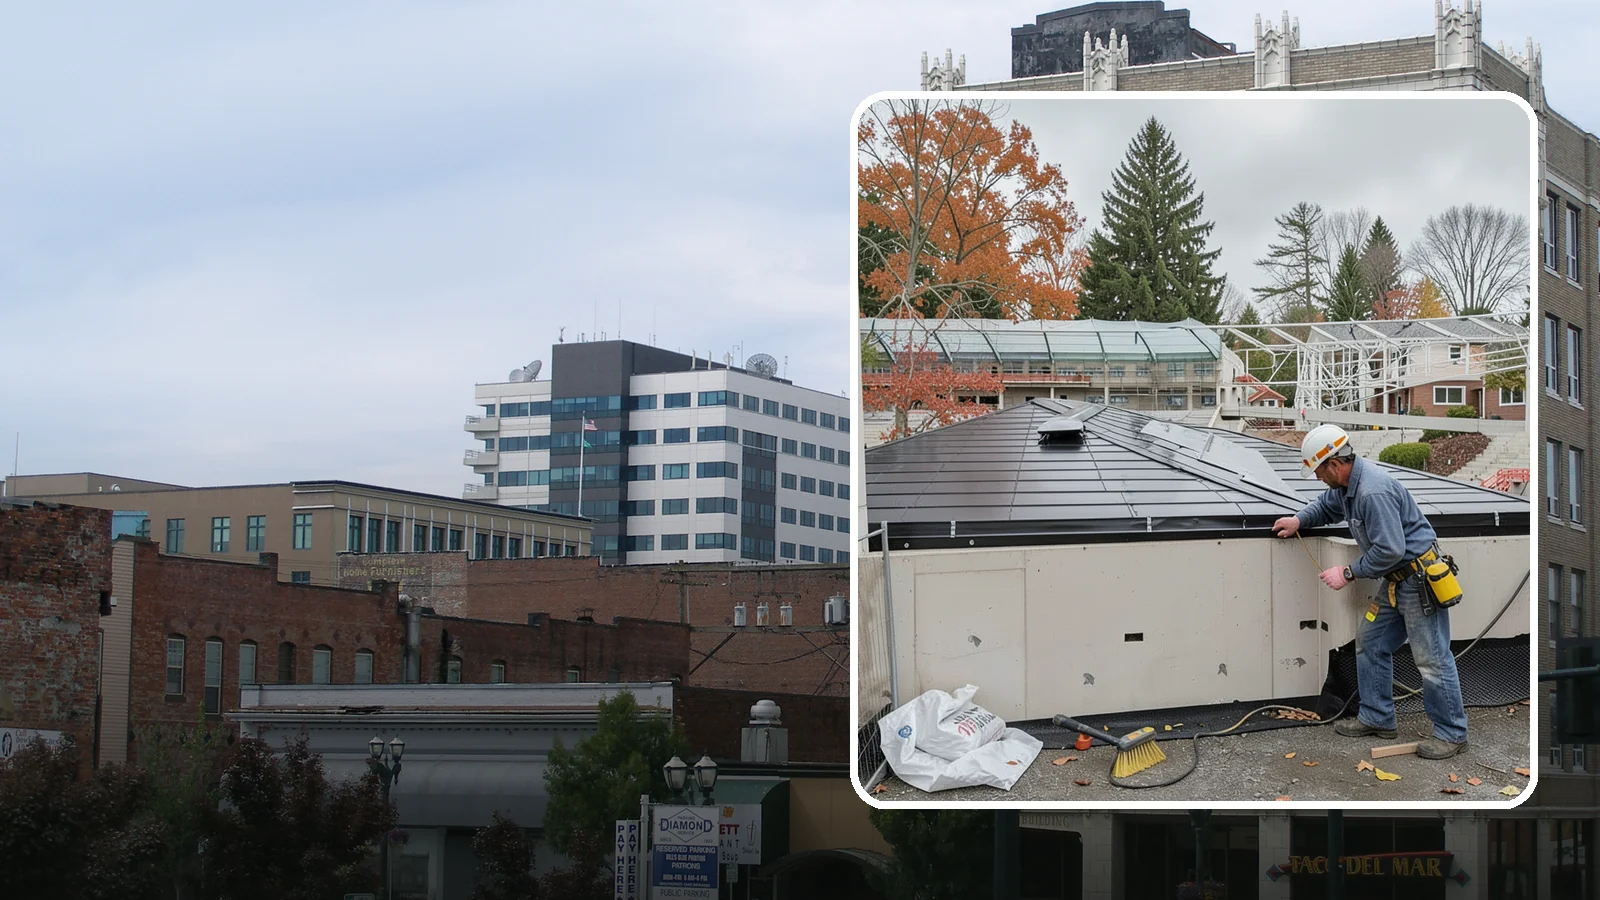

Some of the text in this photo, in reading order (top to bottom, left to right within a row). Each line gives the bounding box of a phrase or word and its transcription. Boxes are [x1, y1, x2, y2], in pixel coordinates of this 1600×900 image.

[371, 566, 427, 576] Furnishers
[660, 818, 713, 832] DIAMOND
[1022, 815, 1070, 828] BUILDING
[617, 825, 625, 852] PAY
[656, 845, 716, 854] RESERVED PARKING
[671, 862, 701, 870] PATRONS
[1289, 855, 1441, 877] TAC DEL MAR
[628, 856, 636, 893] HERE
[660, 888, 710, 898] PUBLIC PARKING
